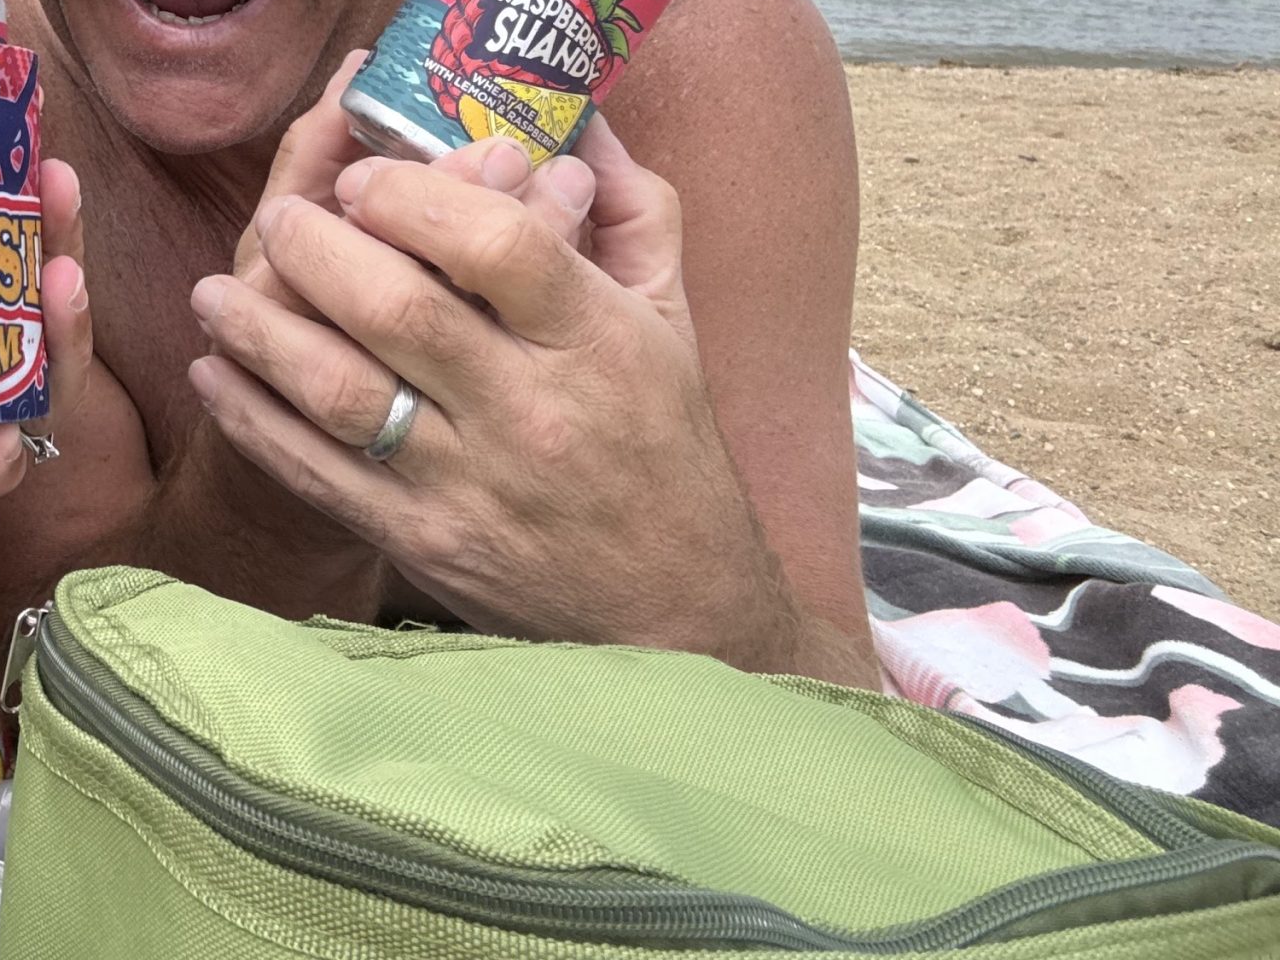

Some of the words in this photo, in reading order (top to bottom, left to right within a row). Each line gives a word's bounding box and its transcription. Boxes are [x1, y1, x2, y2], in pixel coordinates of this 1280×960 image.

[484, 6, 600, 86] SHANDY
[423, 57, 455, 82] WITH
[453, 76, 497, 108] LEMON
[496, 104, 505, 115] &
[506, 110, 560, 151] RASPBERRY
[472, 72, 515, 105] WHEAT
[515, 101, 537, 121] ALE
